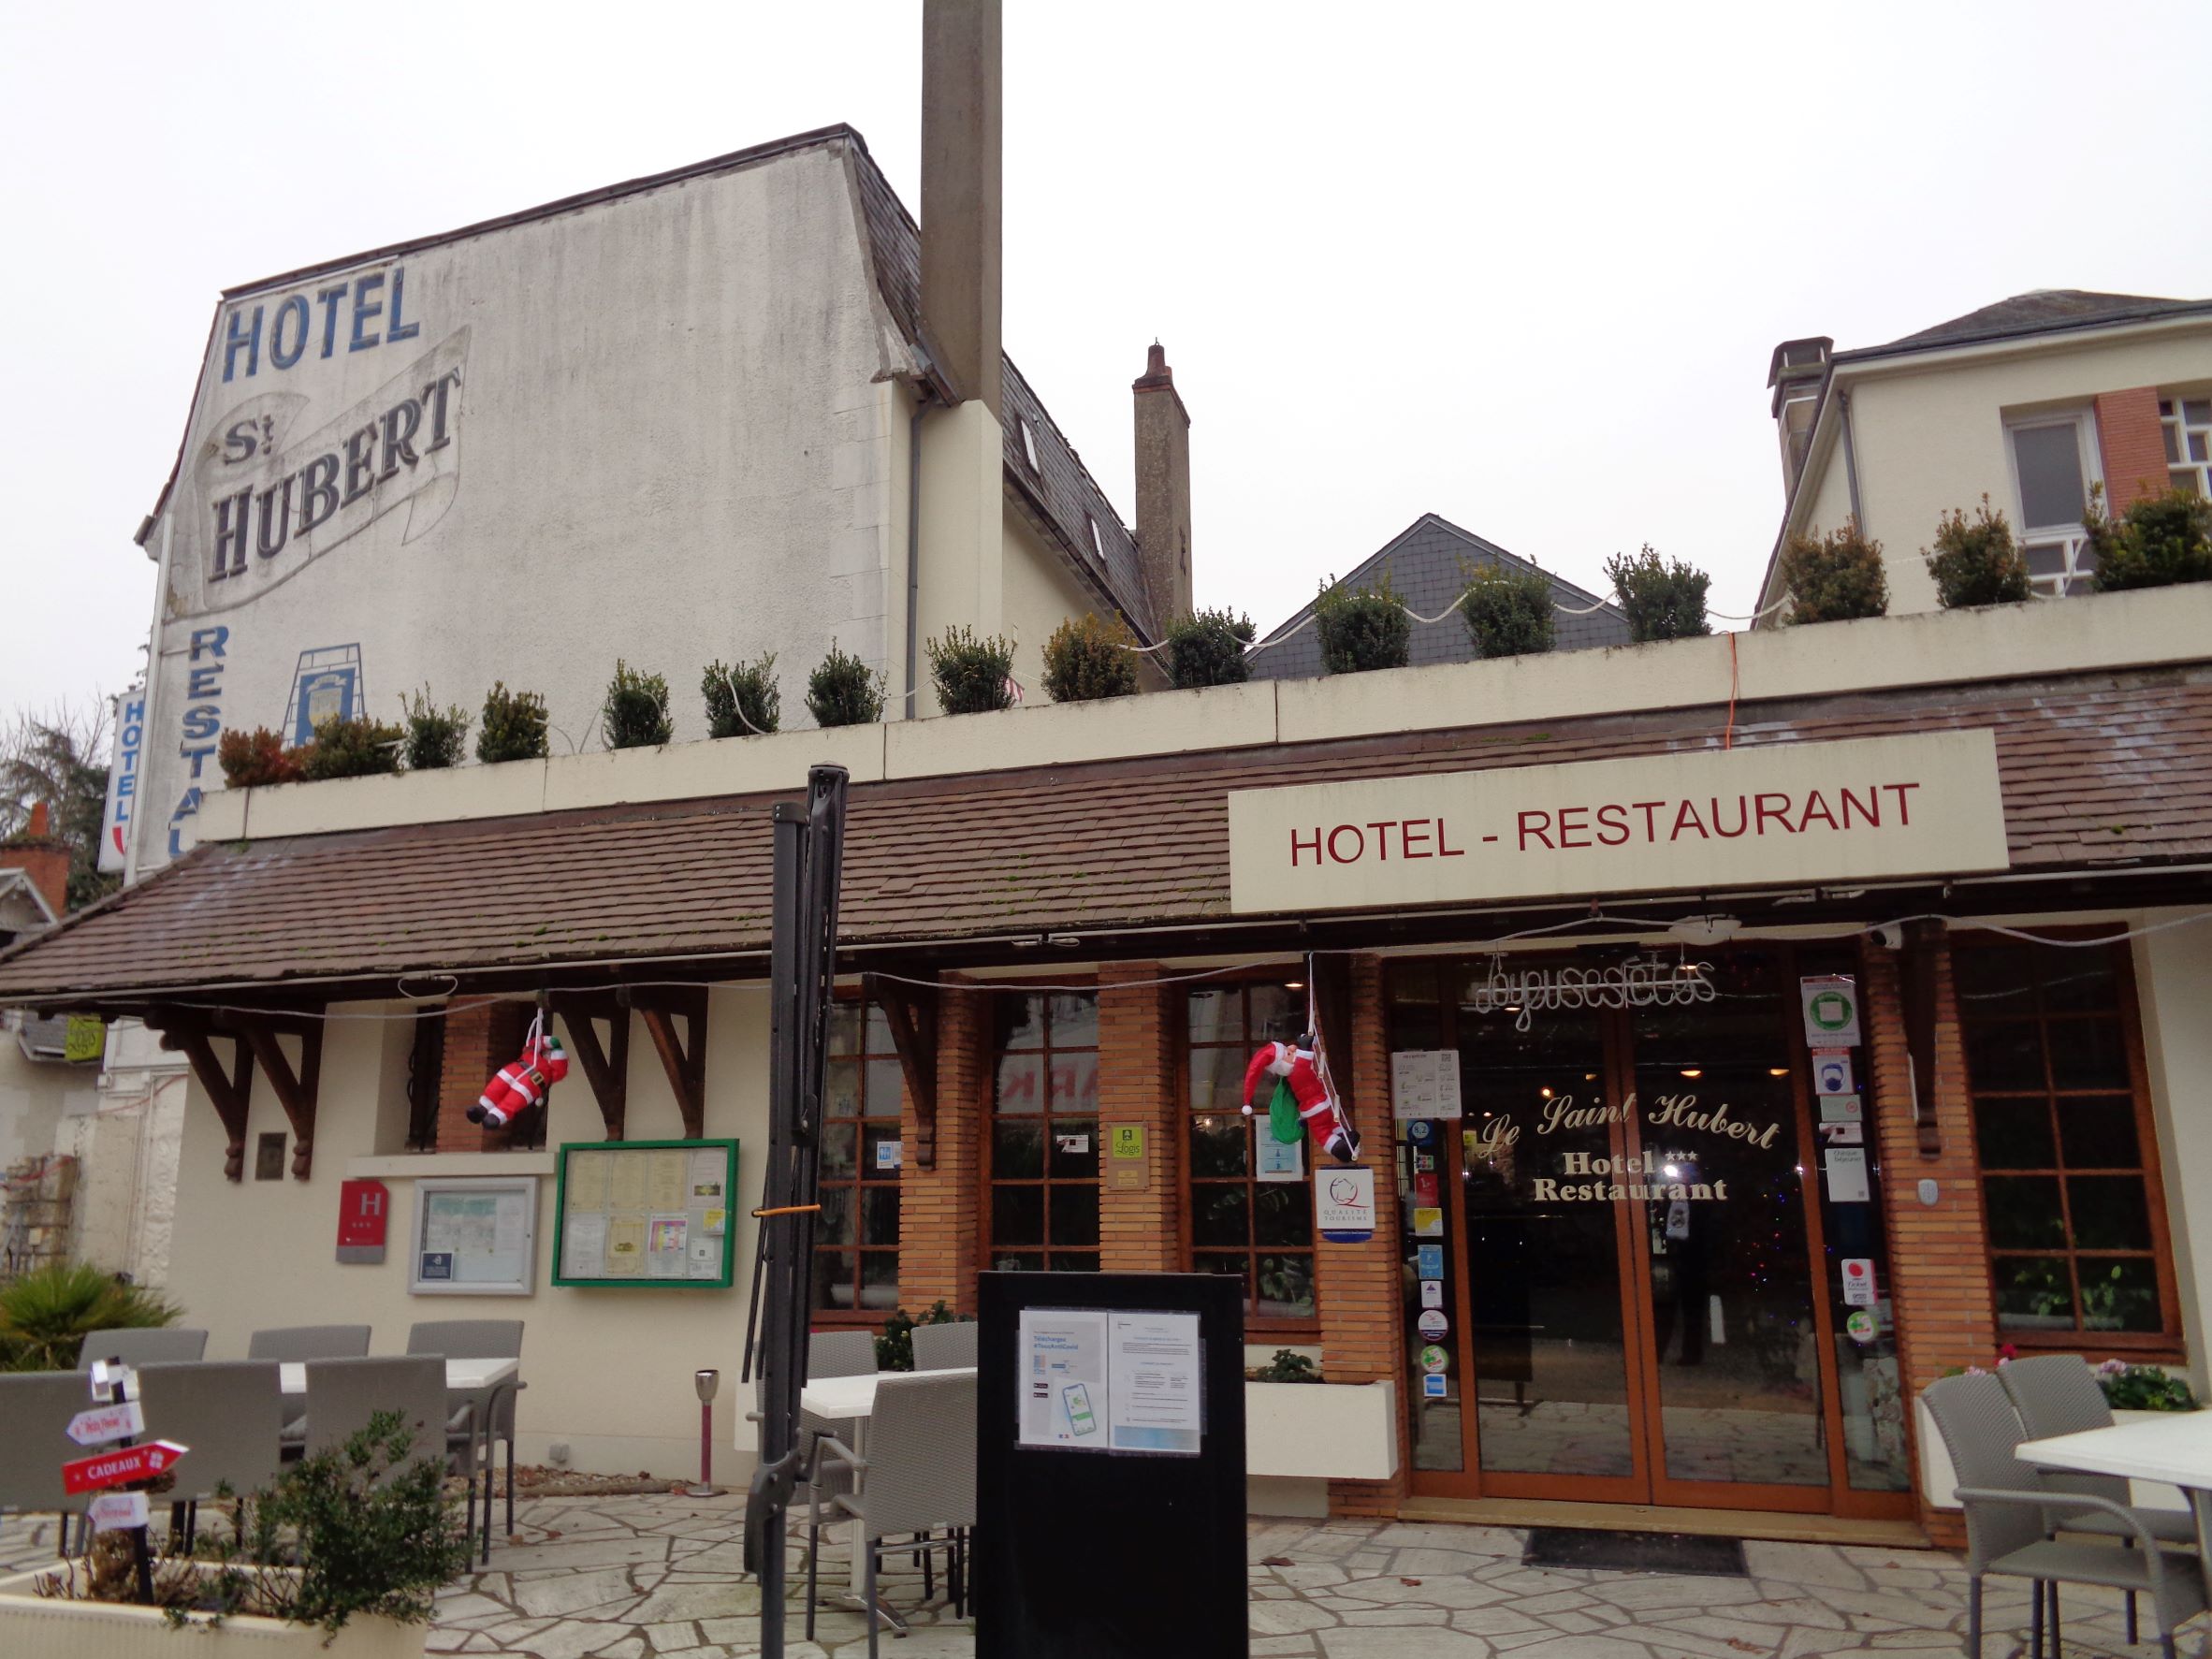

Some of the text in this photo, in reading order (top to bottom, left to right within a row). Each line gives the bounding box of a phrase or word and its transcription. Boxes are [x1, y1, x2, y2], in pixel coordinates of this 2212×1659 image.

[223, 266, 420, 384] HOTEL
[208, 366, 461, 583] HUBERT
[115, 700, 144, 822] HOTEL
[1290, 817, 1465, 867] HOTEL
[1518, 782, 1922, 851] RESTAURANT
[1478, 1092, 1781, 1159] Le Saint Hubert
[1115, 1142, 1141, 1156] Logis
[1563, 1150, 1657, 1175] Hotel
[360, 1192, 381, 1215] H
[1533, 1178, 1730, 1202] Restaurant
[87, 1456, 141, 1479] CADEAUX
